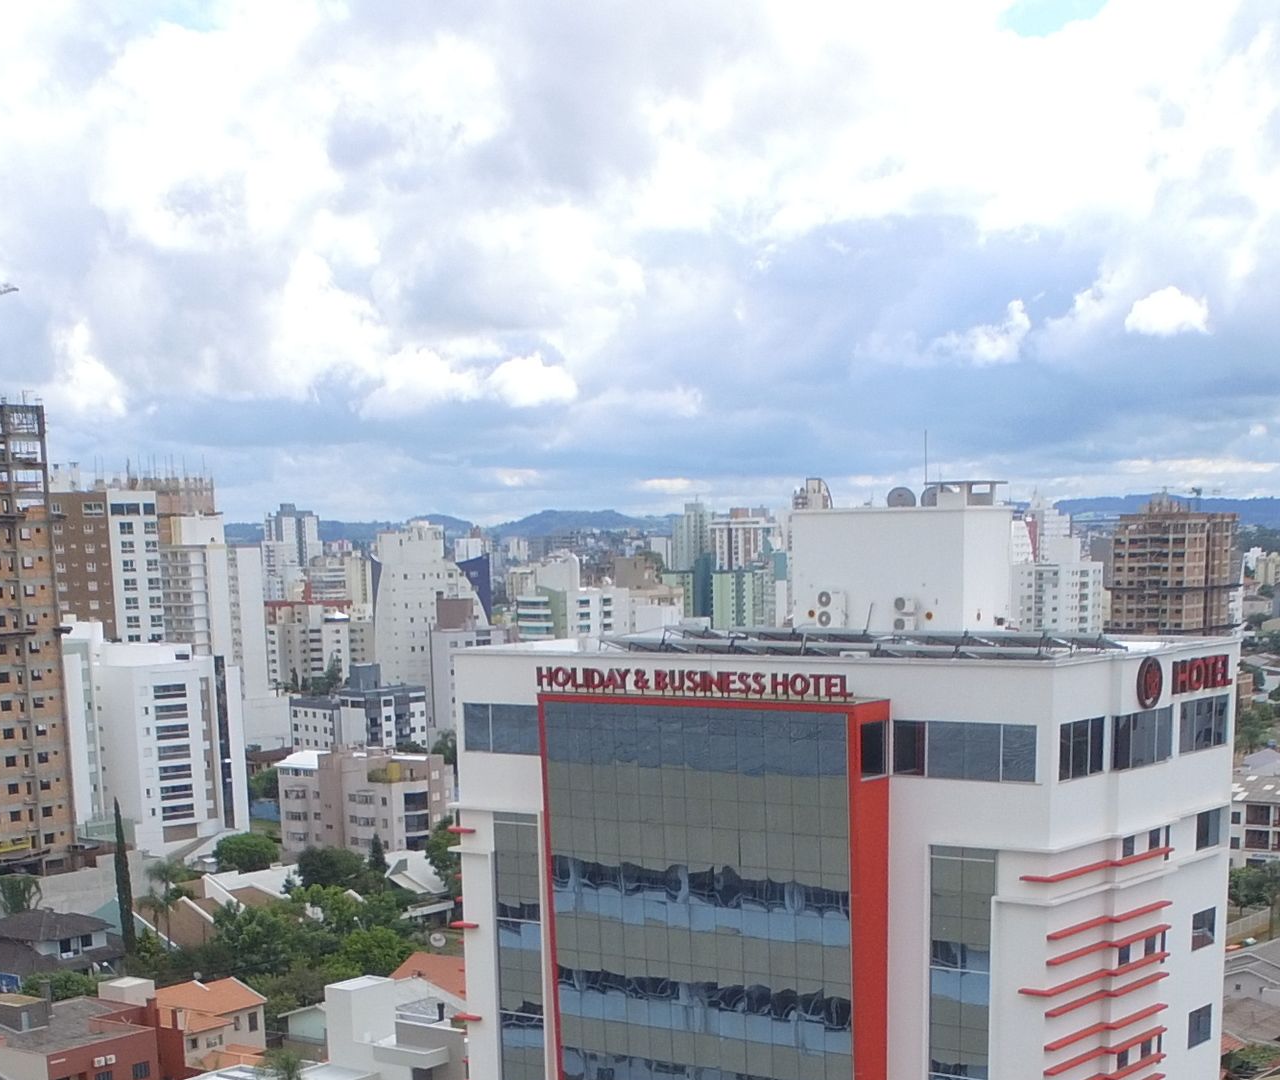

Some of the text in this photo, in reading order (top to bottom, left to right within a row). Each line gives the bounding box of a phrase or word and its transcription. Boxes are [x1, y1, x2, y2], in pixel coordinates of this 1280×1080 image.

[536, 666, 854, 697] HOLIDAY & BUSINESS HOTEL
[1171, 655, 1233, 695] HOTEL
